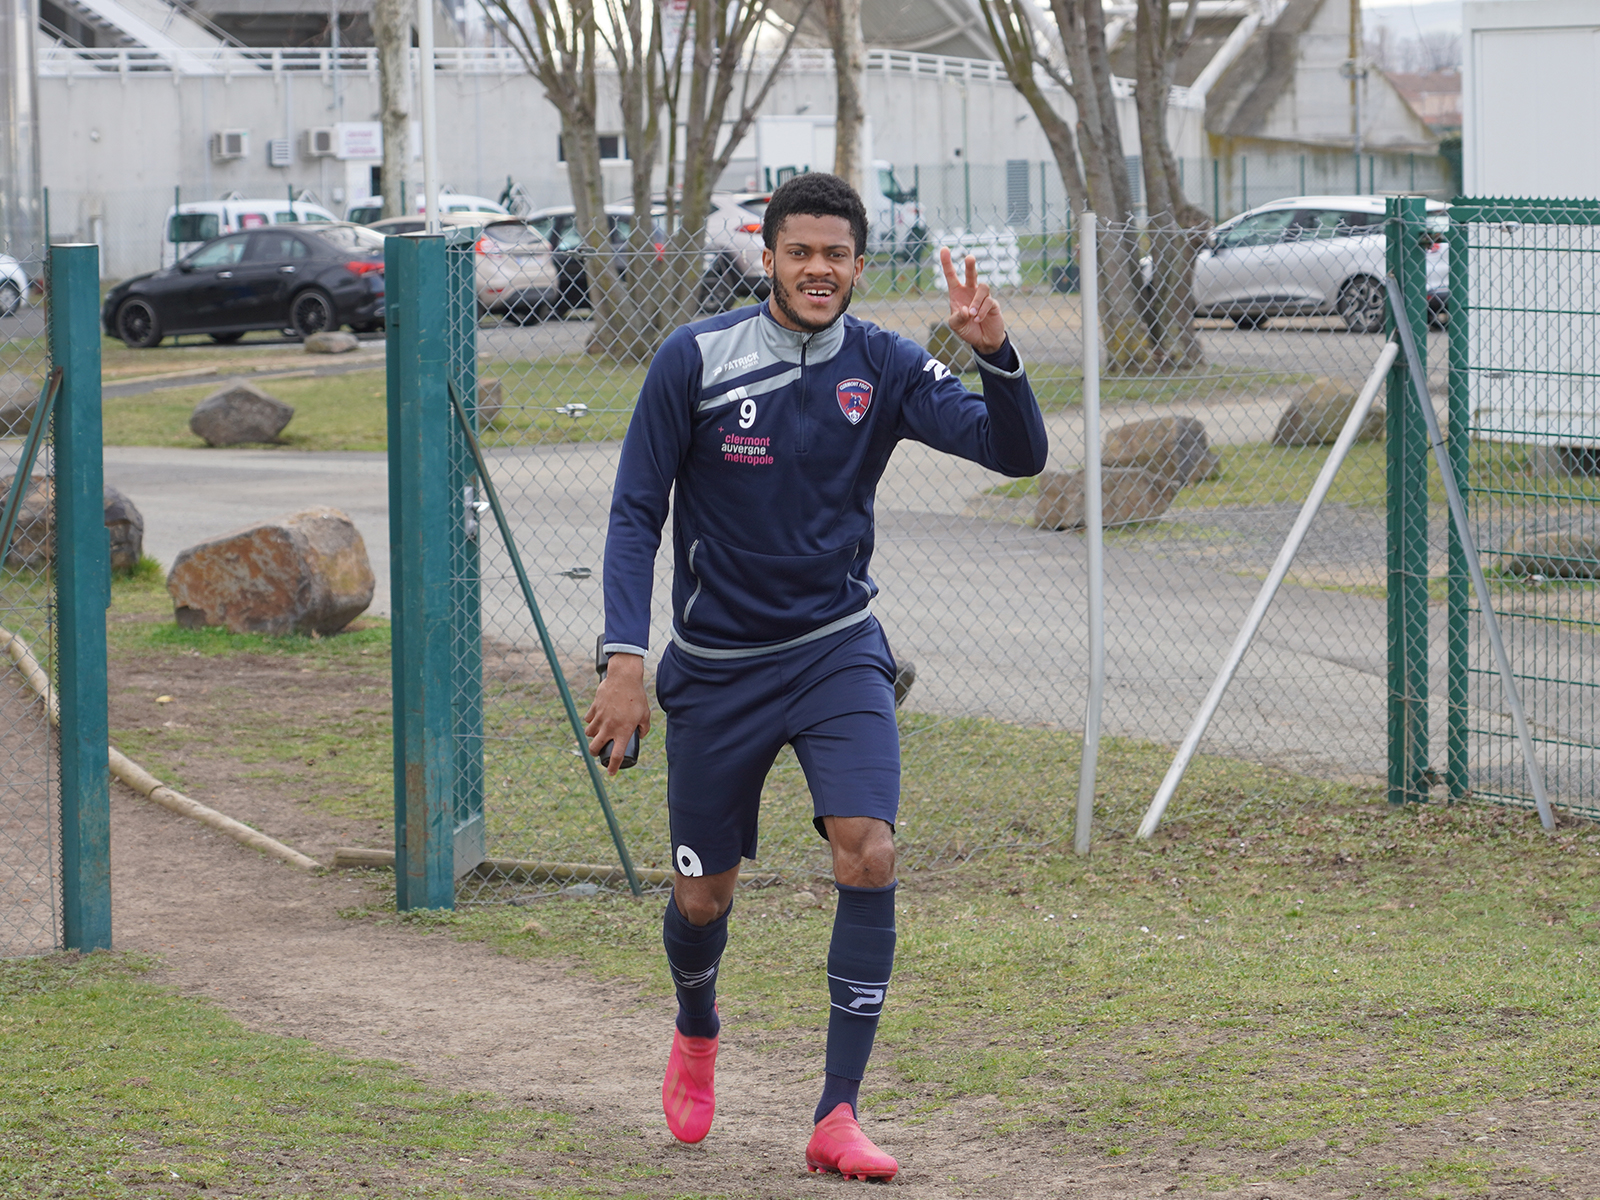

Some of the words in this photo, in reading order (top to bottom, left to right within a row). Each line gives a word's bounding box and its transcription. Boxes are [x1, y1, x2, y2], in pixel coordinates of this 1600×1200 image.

[738, 398, 757, 429] 9
[725, 433, 770, 447] clermont
[721, 443, 767, 455] auvergne
